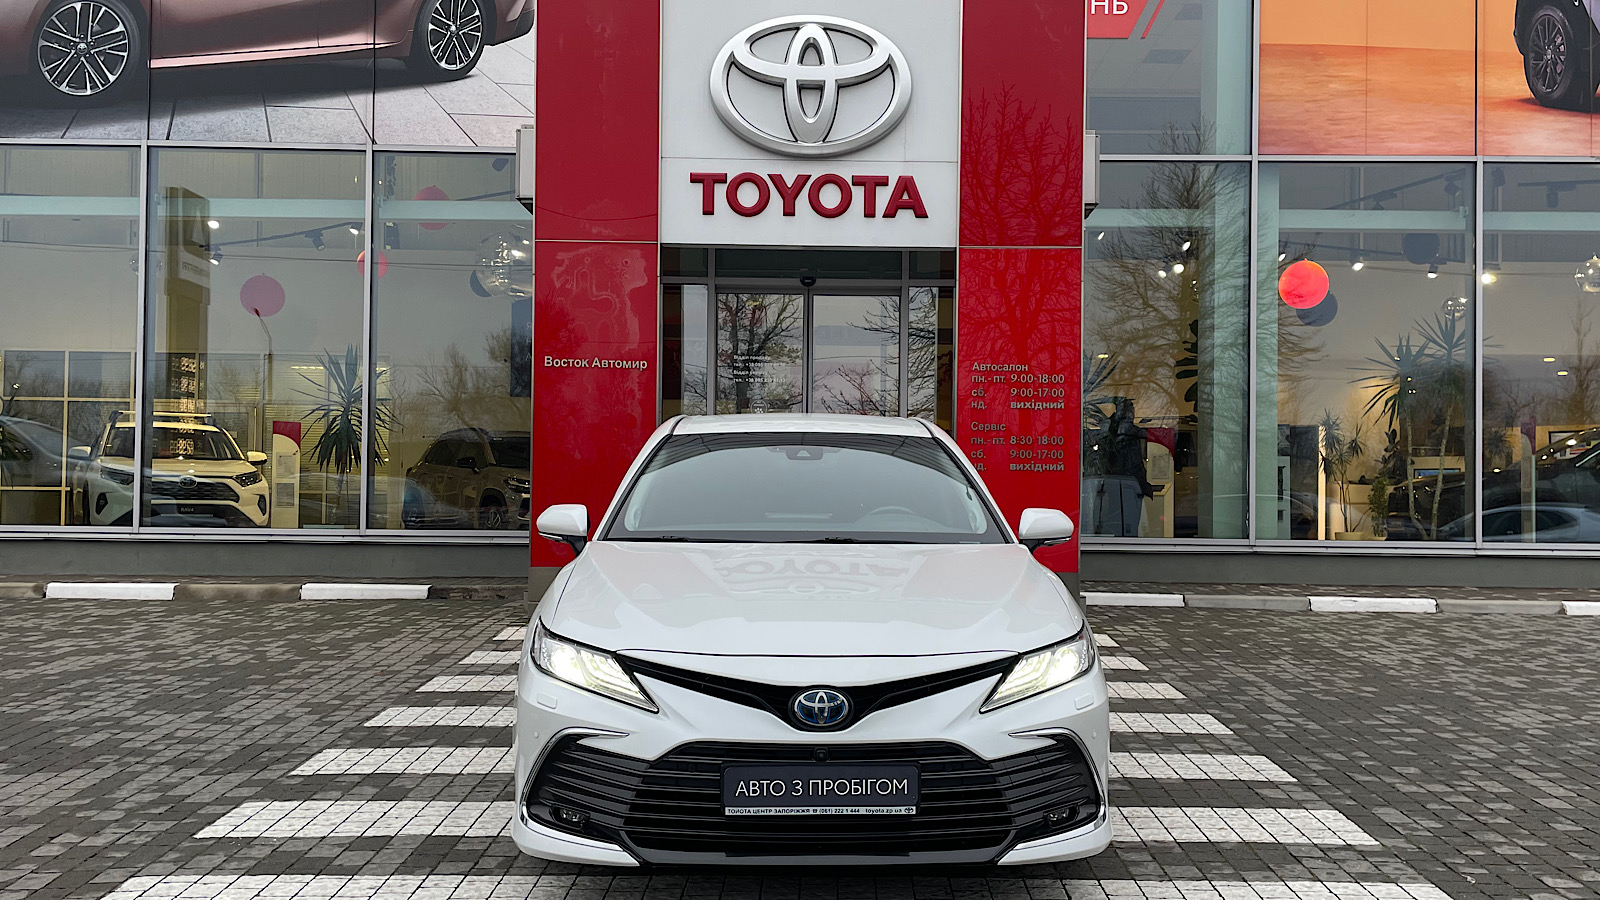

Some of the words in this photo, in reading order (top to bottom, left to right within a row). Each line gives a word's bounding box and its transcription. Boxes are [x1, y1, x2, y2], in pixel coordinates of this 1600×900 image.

[690, 171, 929, 219] TOYOTA
[544, 355, 589, 368] Восток
[591, 357, 648, 371] Автомир
[972, 362, 1028, 371] Автосалон
[971, 388, 987, 397] сб.
[1010, 388, 1065, 397] 9:00-17:00
[971, 401, 987, 409] нд.
[1010, 400, 1064, 410] вихідний
[970, 422, 1006, 432] Сервіс
[970, 449, 987, 458] сб.
[1009, 449, 1064, 459] 9:00-17:00
[1009, 461, 1064, 472] вихідний
[735, 780, 786, 797] АВТО
[809, 778, 908, 796] ПРОБІГОМ
